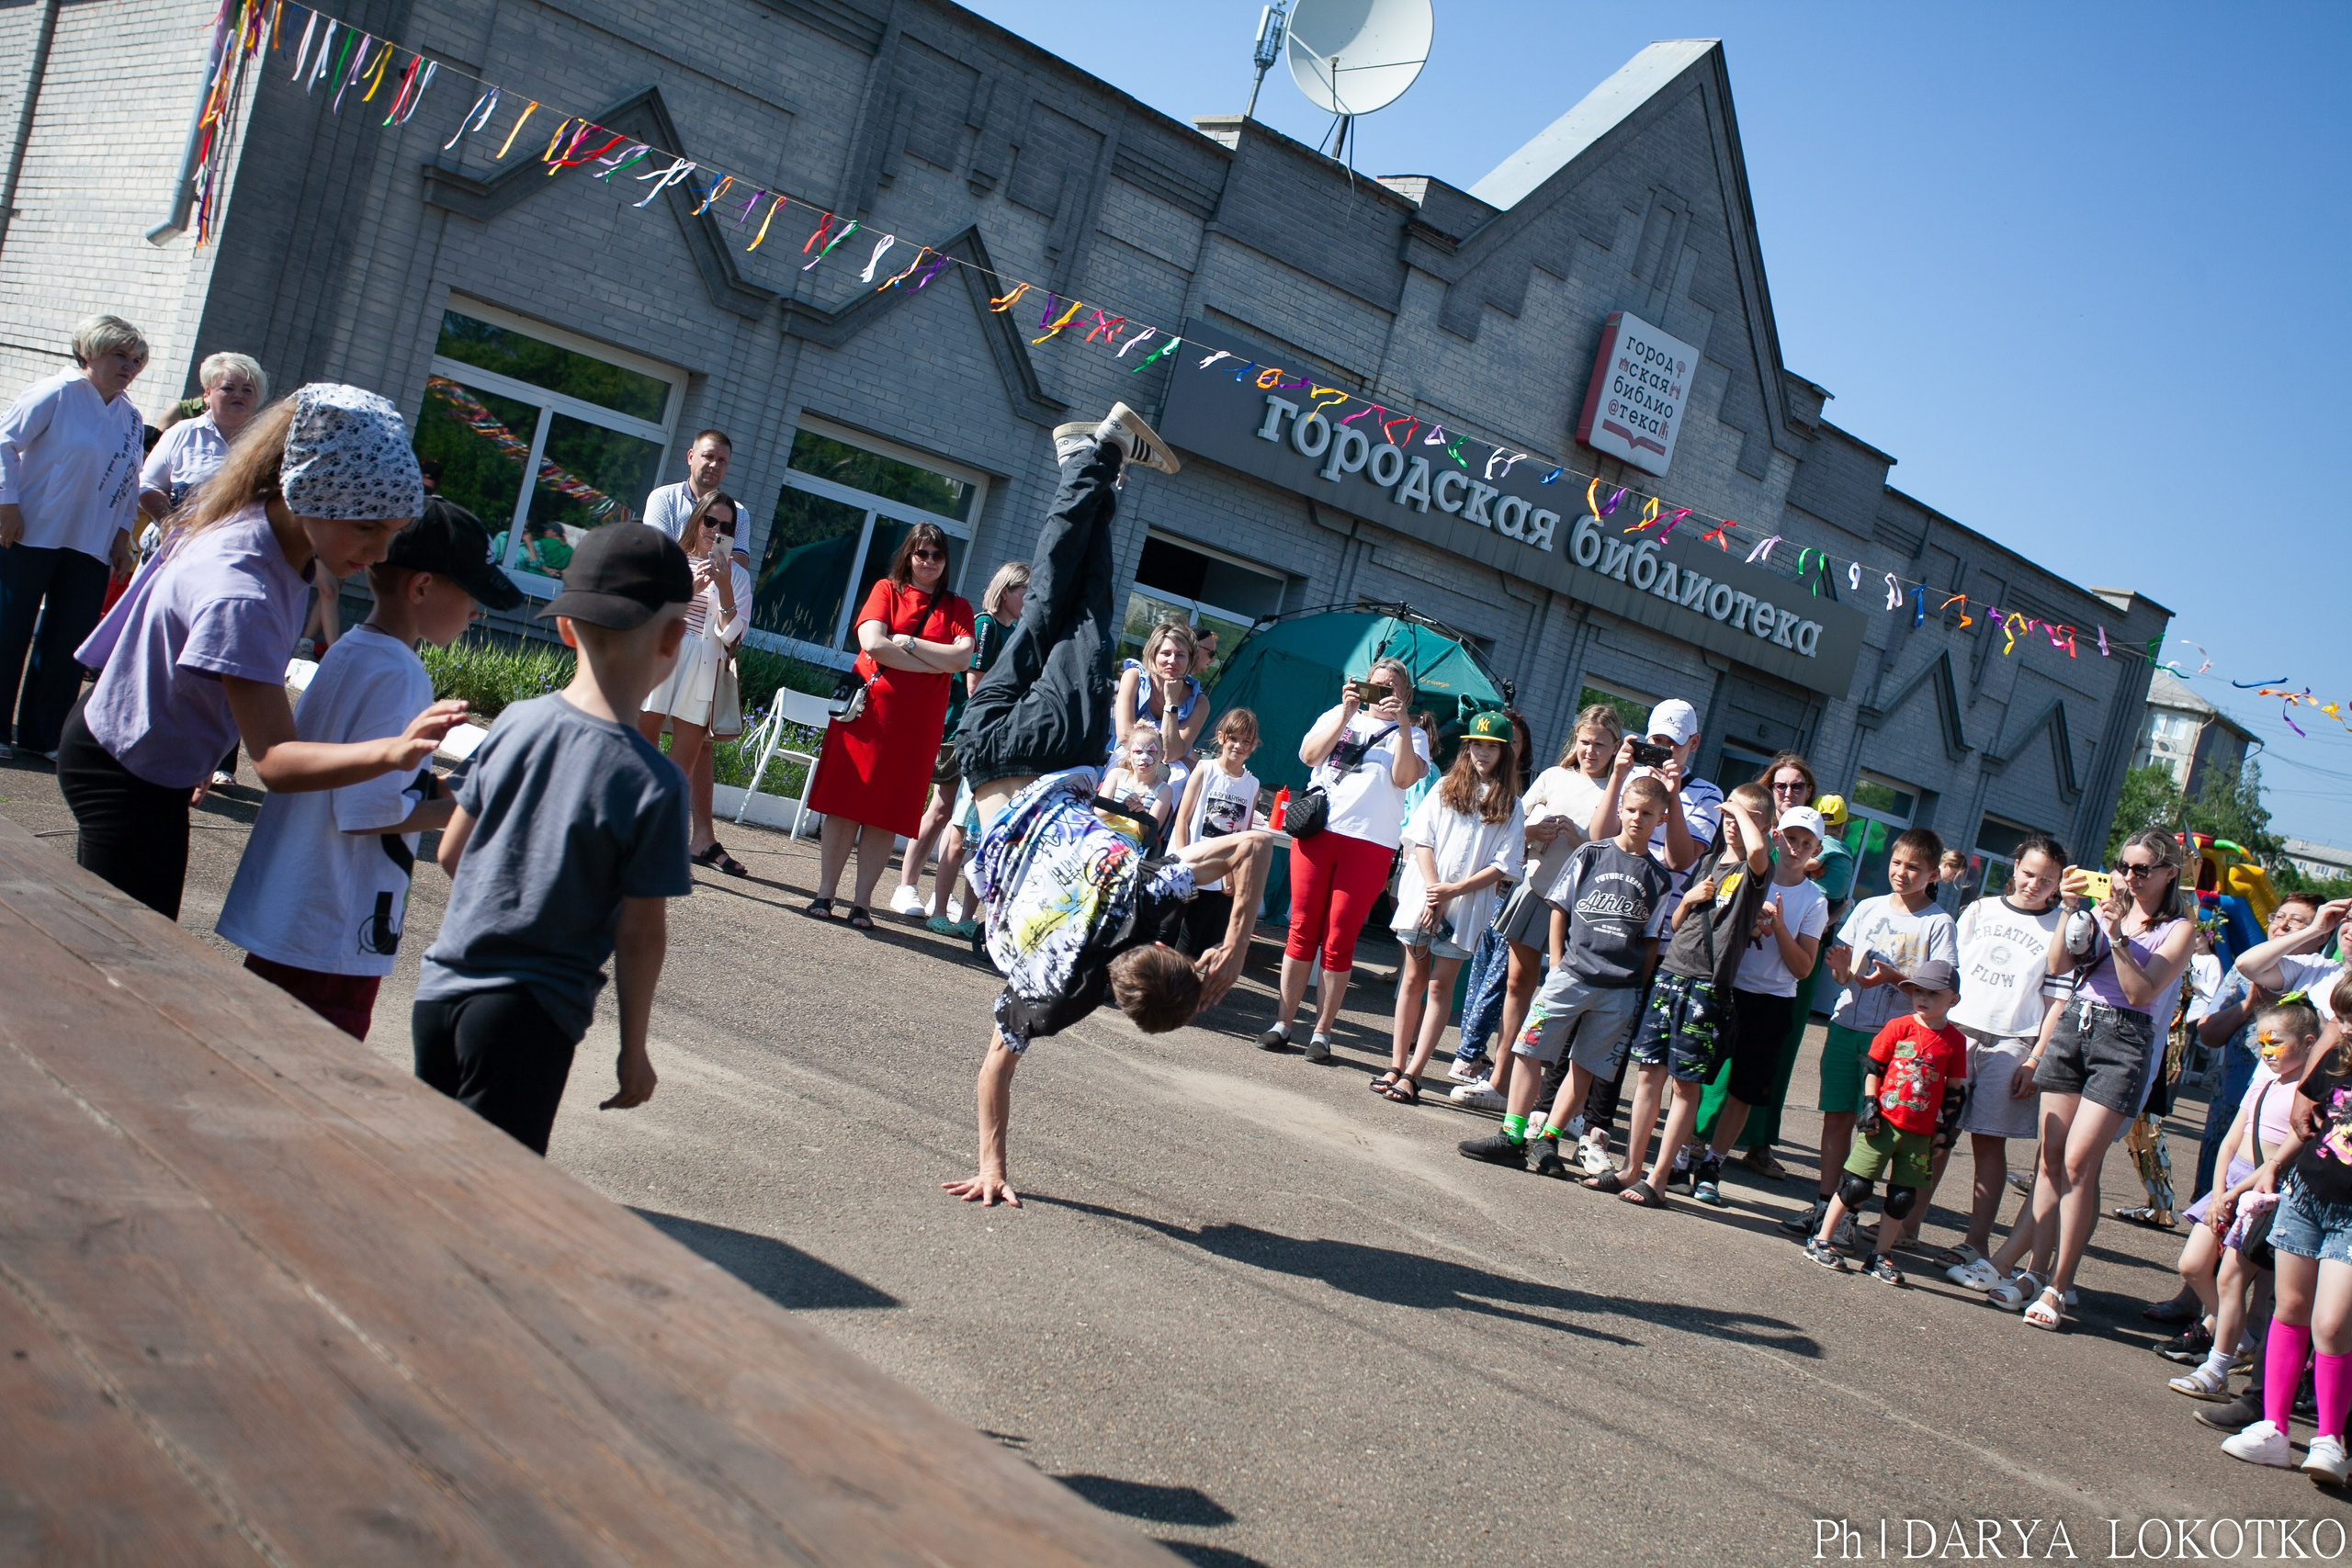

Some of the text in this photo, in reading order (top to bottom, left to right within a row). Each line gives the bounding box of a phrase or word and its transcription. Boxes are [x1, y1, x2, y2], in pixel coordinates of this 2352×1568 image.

[1626, 336, 1673, 375] город
[1629, 363, 1670, 394] ская
[1613, 375, 1673, 419] библио
[1257, 395, 1824, 659] городская библиотека
[1476, 716, 1490, 732] NY
[1594, 872, 1647, 897] FUTURE LEADER
[1576, 889, 1651, 919] Athletic
[1973, 924, 2045, 956] CREATIVE
[1970, 964, 2016, 987] FLOW
